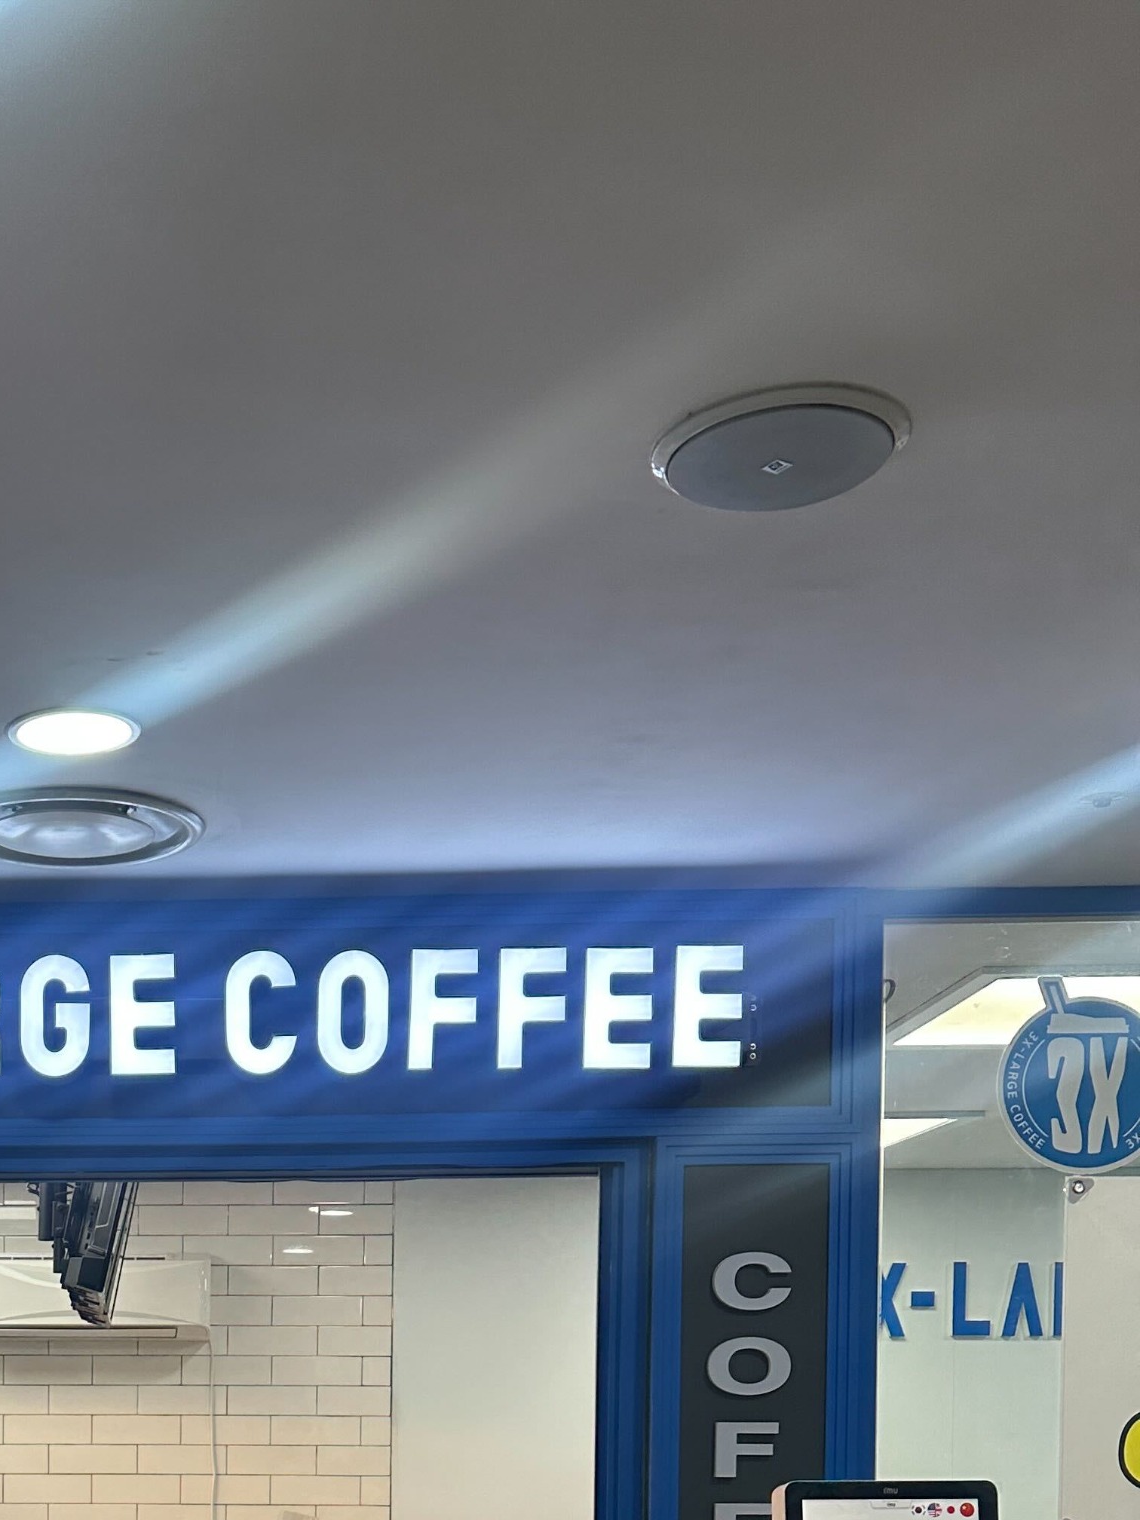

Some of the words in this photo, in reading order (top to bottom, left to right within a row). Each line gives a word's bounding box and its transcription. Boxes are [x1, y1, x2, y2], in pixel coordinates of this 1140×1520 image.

[225, 944, 744, 1076] COFFEE
[1007, 1031, 1039, 1099] 3X-LARGE
[1047, 1037, 1128, 1154] 3X
[1010, 1104, 1046, 1150] COFFEE
